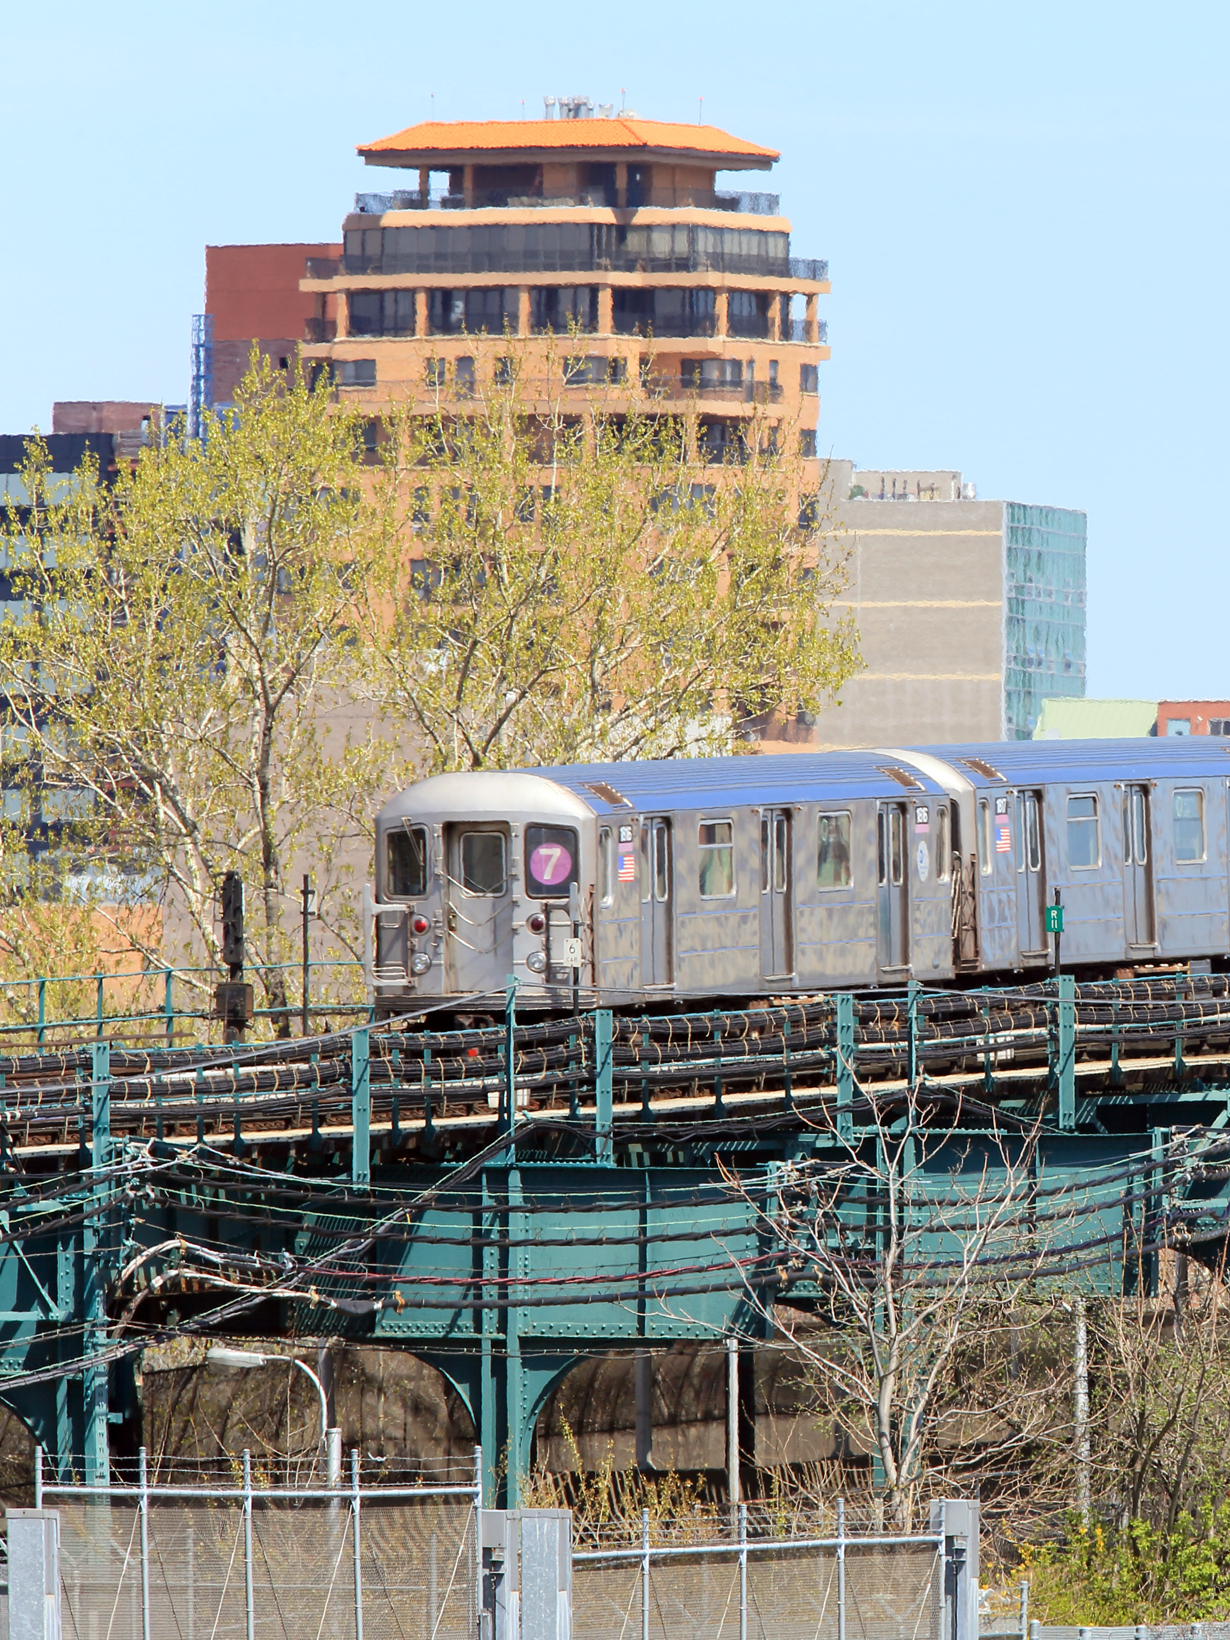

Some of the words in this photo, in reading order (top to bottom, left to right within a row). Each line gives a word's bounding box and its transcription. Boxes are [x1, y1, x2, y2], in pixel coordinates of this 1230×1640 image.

[539, 848, 562, 880] 7
[1050, 910, 1058, 919] R
[568, 943, 576, 954] 6
